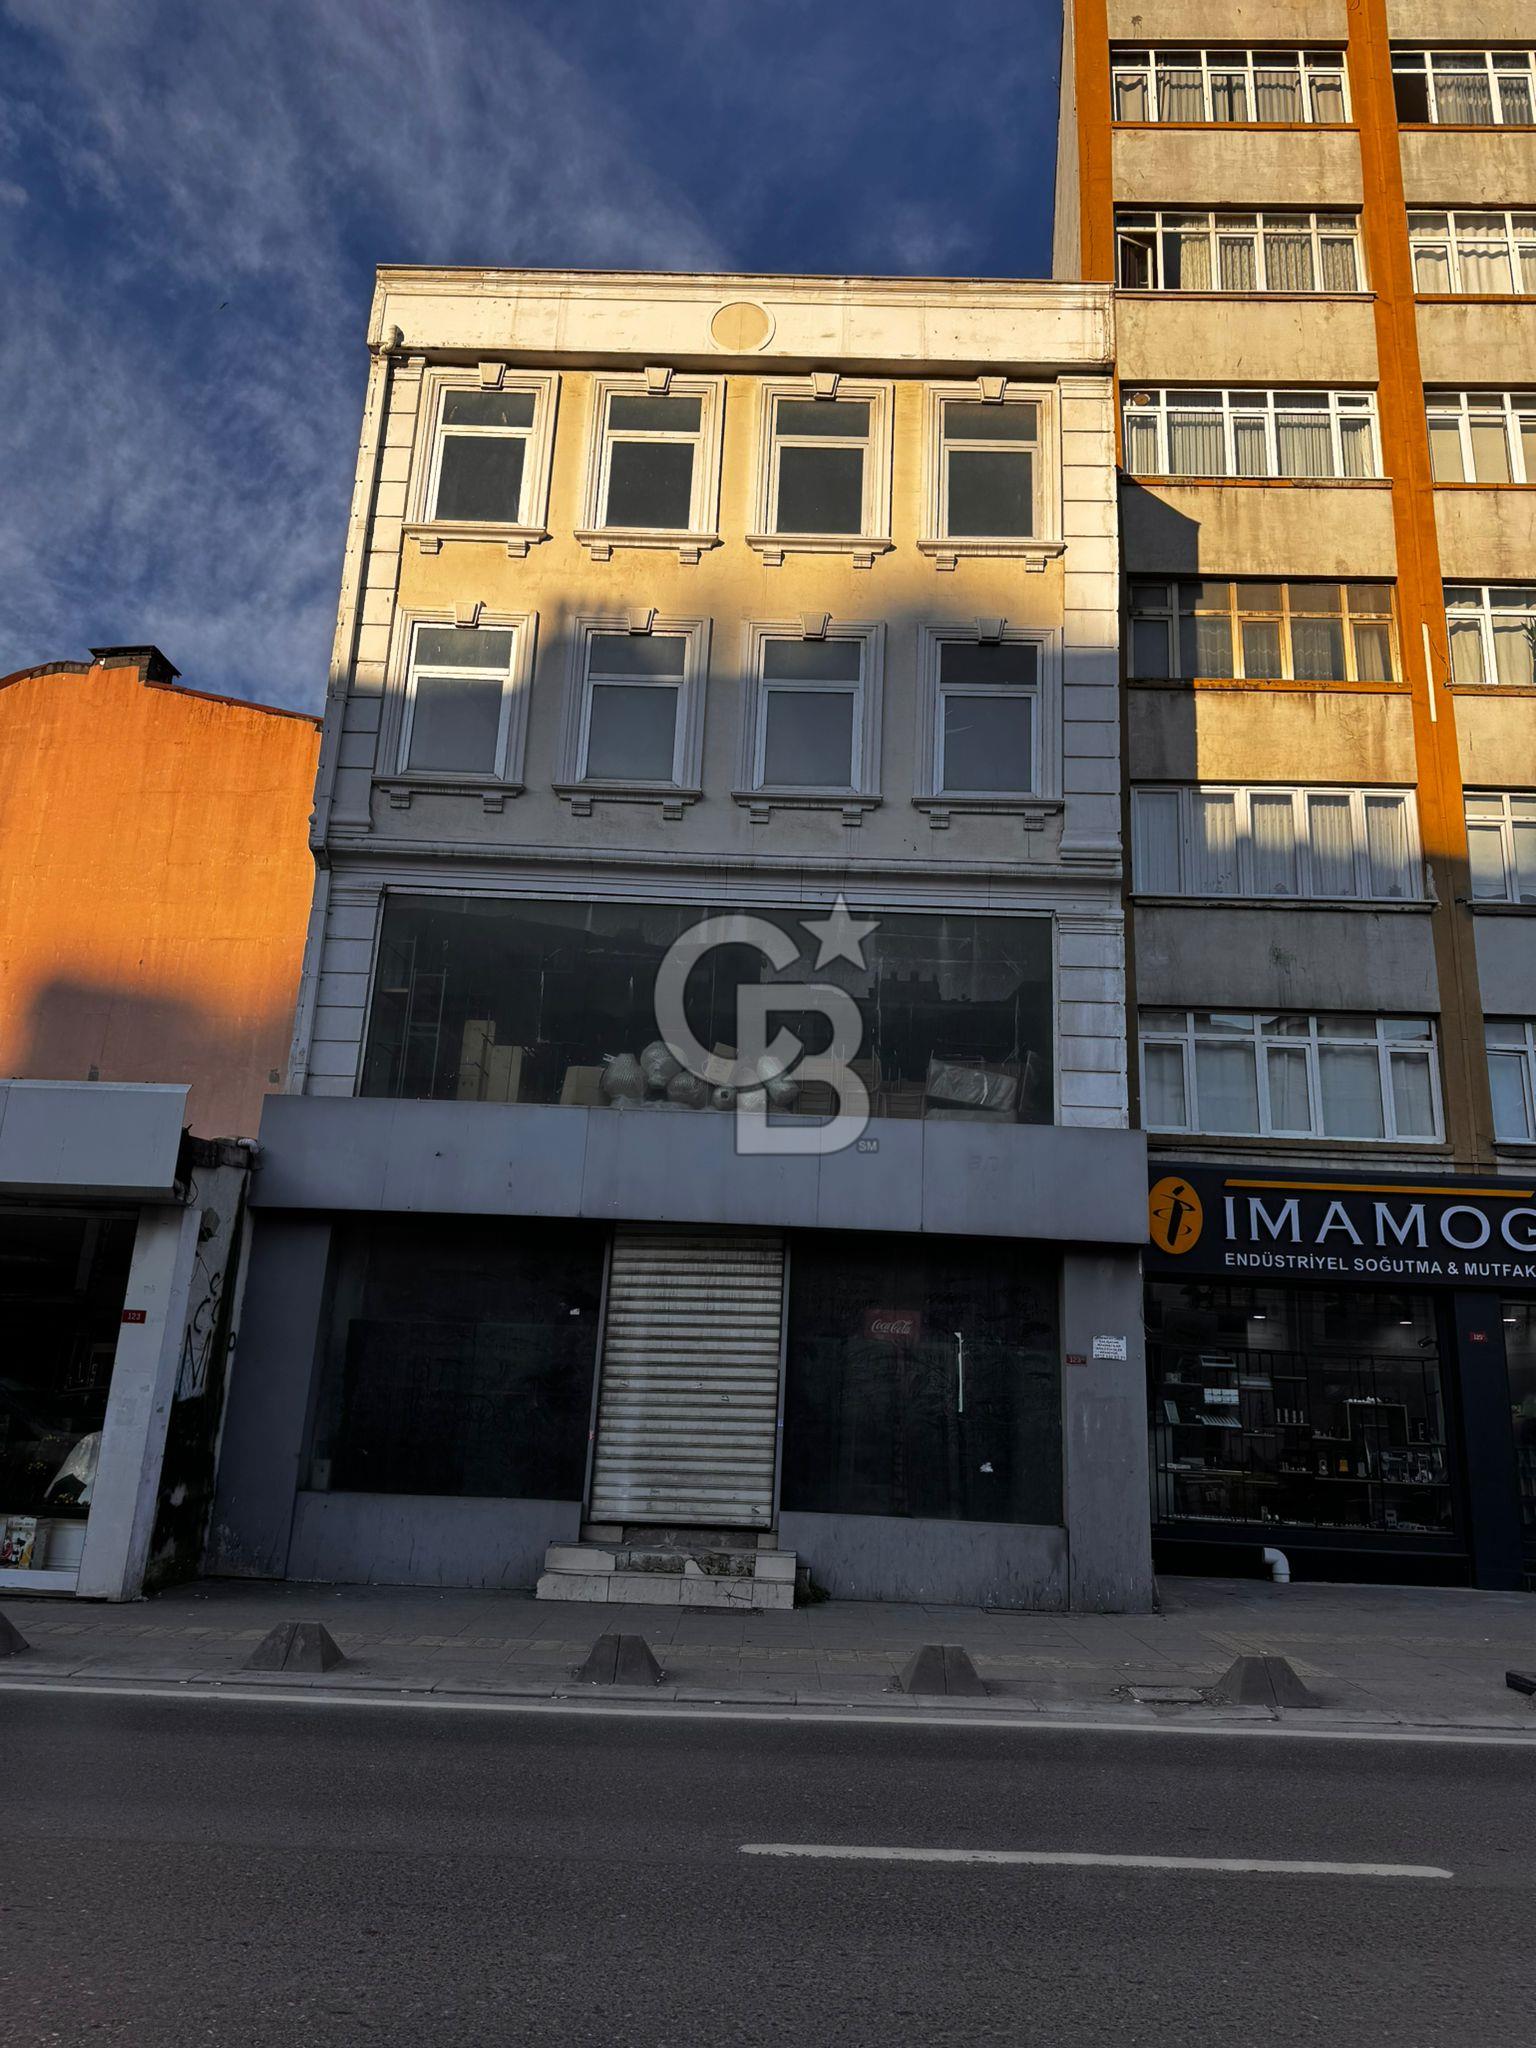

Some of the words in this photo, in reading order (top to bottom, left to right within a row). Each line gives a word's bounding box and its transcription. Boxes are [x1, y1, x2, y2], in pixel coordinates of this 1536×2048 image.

[1223, 1196, 1536, 1252] IMAMOG
[1225, 1251, 1349, 1272] ENDÜSTRİYEL
[1354, 1256, 1443, 1274] SOĞUTMA
[1447, 1261, 1459, 1275] &
[1464, 1262, 1536, 1277] MUTFAK
